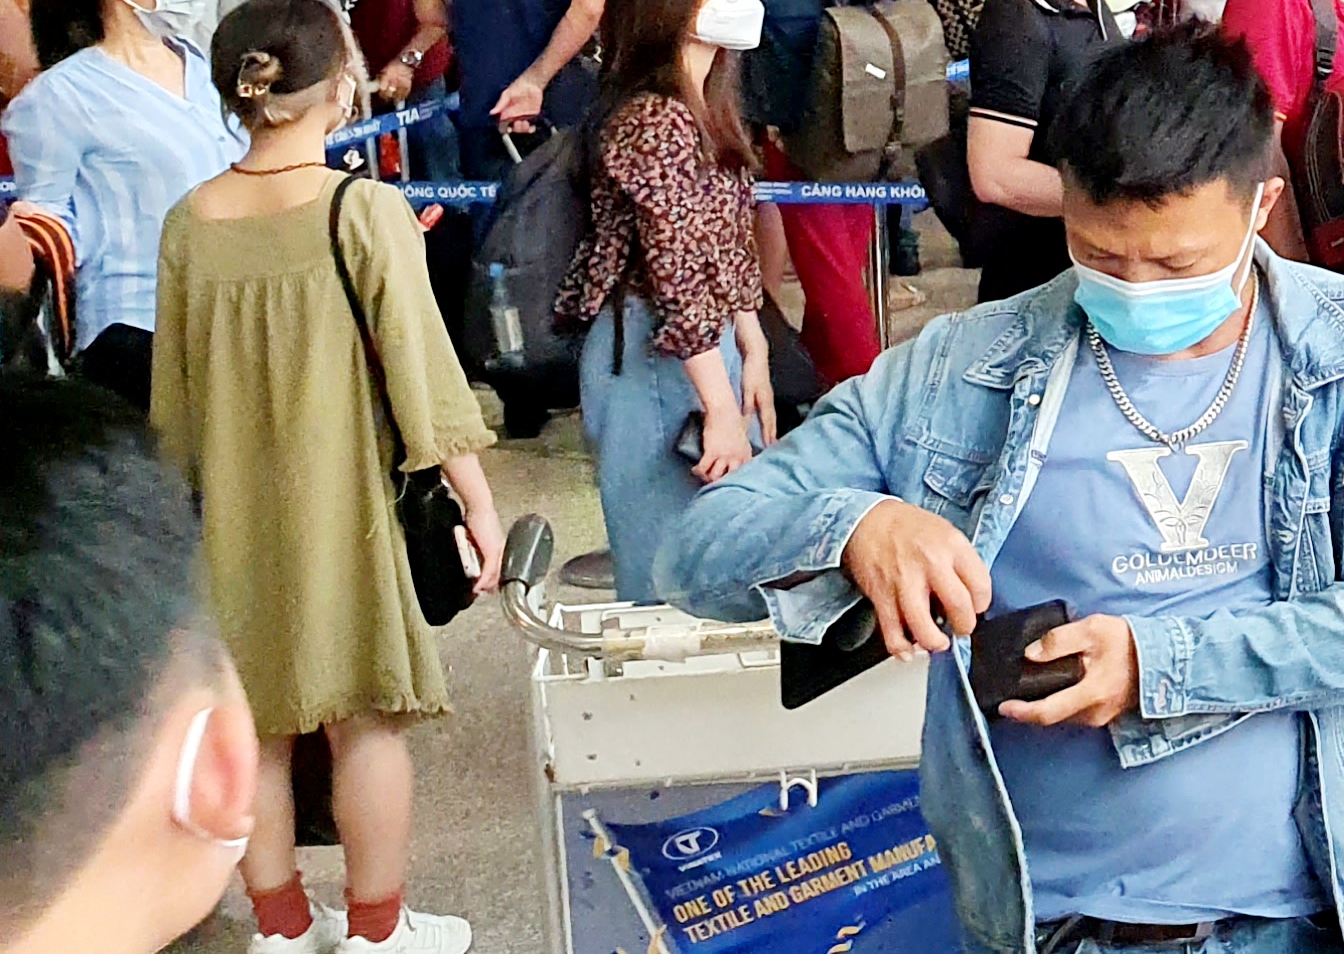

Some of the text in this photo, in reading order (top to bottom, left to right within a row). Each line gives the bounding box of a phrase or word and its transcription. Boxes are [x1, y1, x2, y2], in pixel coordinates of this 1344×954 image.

[396, 108, 420, 127] TIA
[402, 184, 434, 198] ÔNG
[673, 841, 852, 924] ONE OF THE LEADING
[683, 834, 937, 944] TEXTILE AND GARMENT MANUFA
[866, 873, 891, 890] THE
[891, 862, 922, 881] AREA
[923, 850, 942, 870] AN
